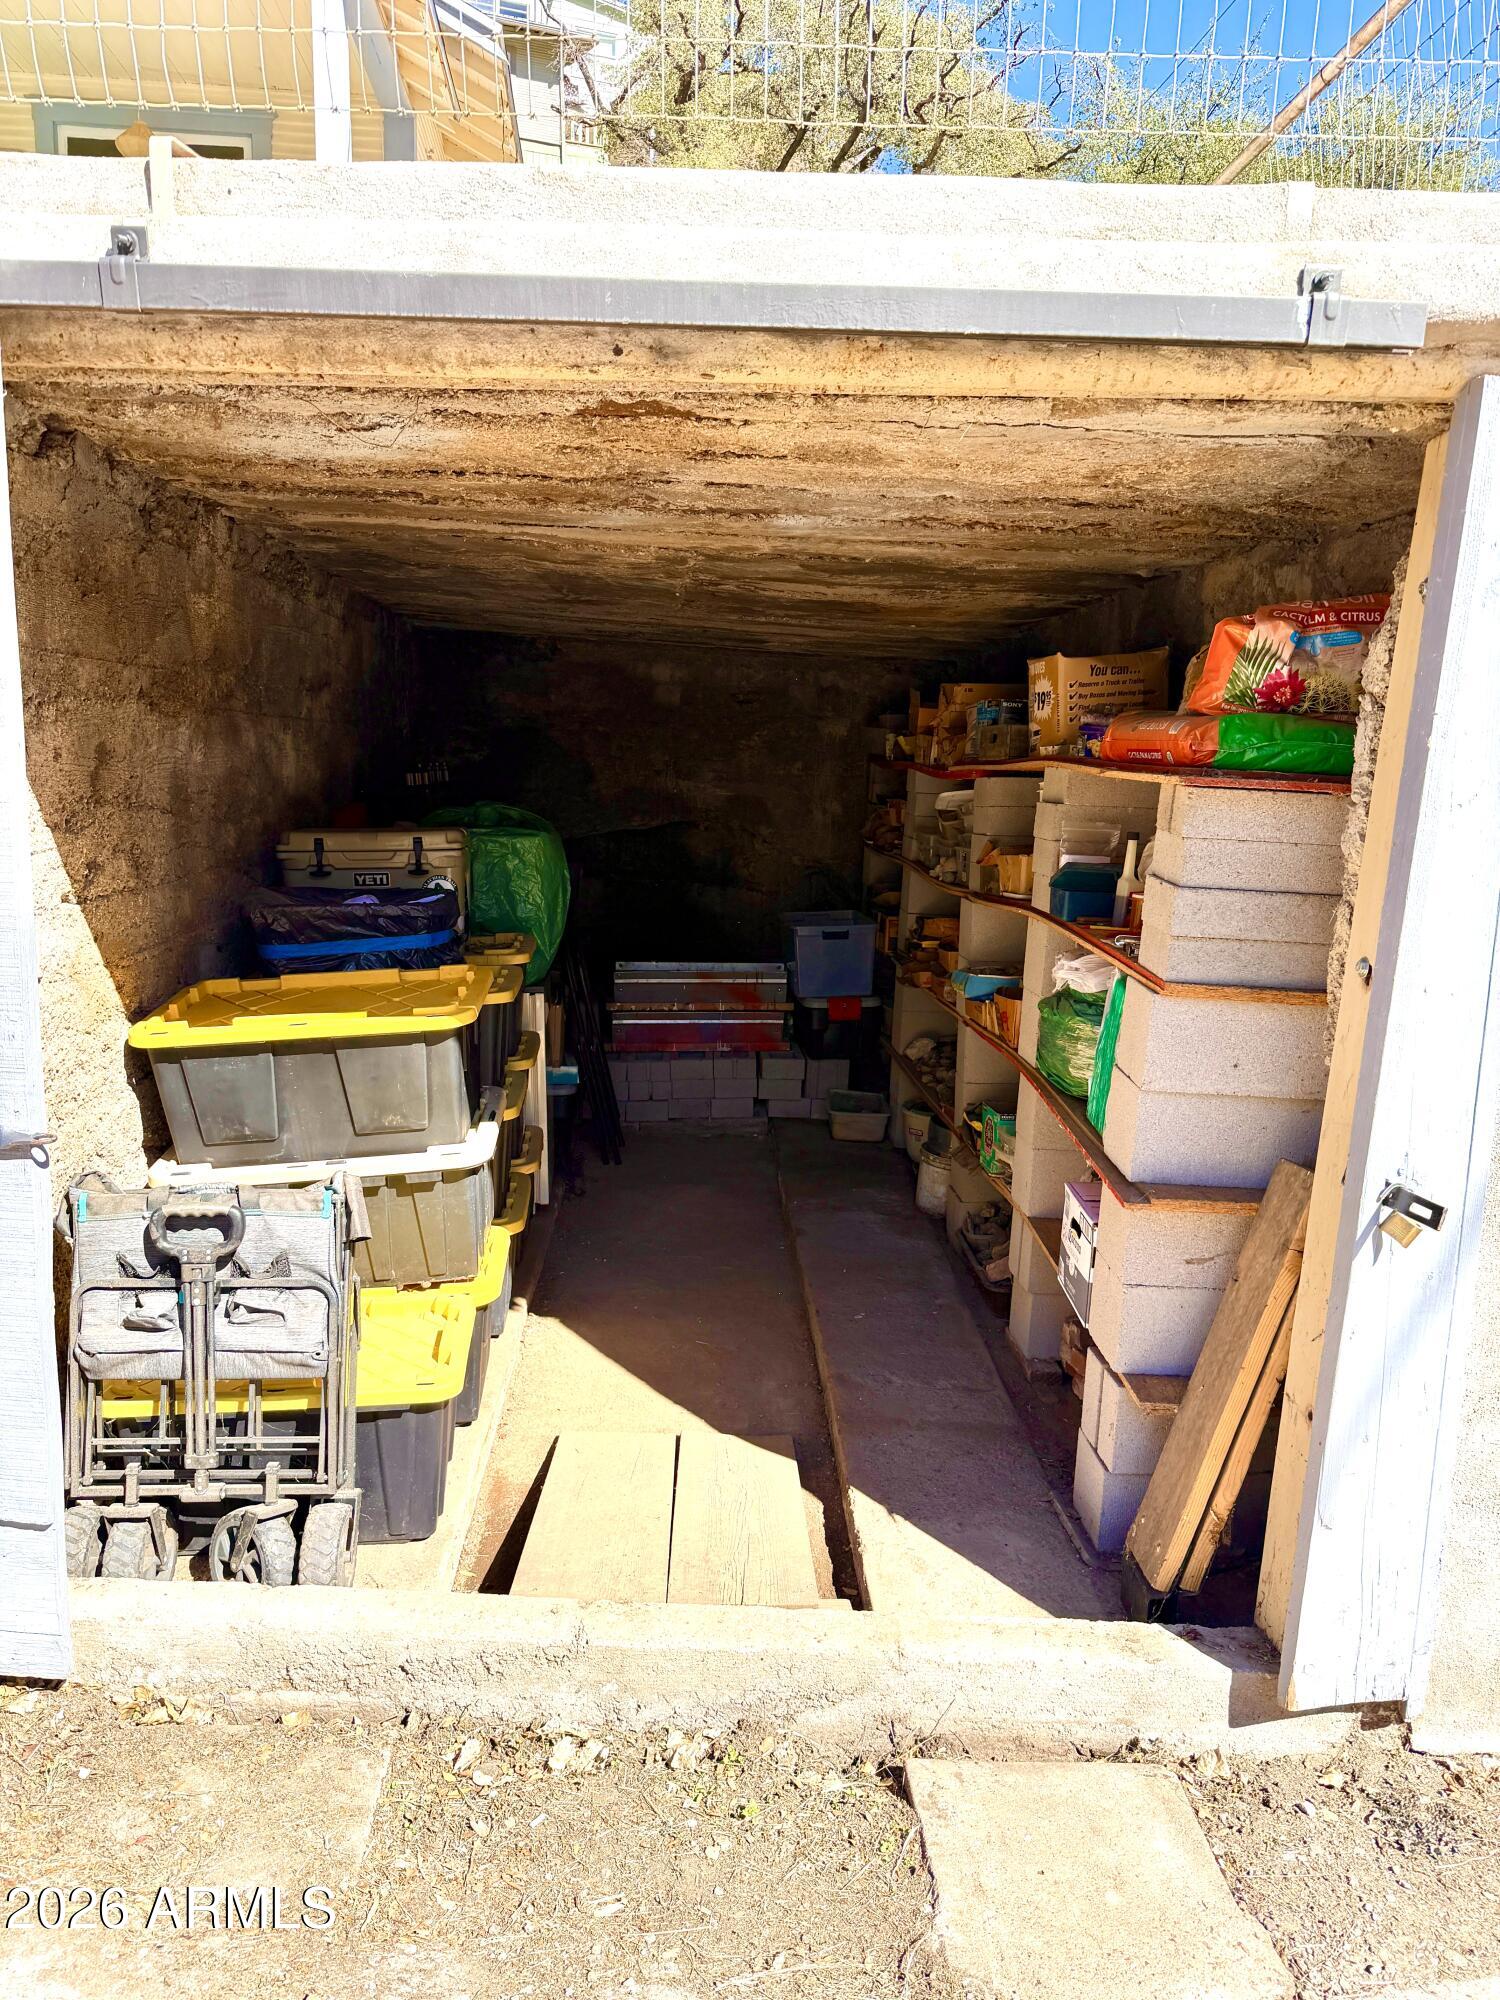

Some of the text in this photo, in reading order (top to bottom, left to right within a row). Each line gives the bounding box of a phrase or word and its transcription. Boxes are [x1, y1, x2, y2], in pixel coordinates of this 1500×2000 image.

[1329, 612, 1338, 622] &
[1340, 612, 1381, 622] CITRUS
[1090, 664, 1108, 677] You
[1106, 679, 1121, 687] Truck
[355, 874, 387, 885] YETI
